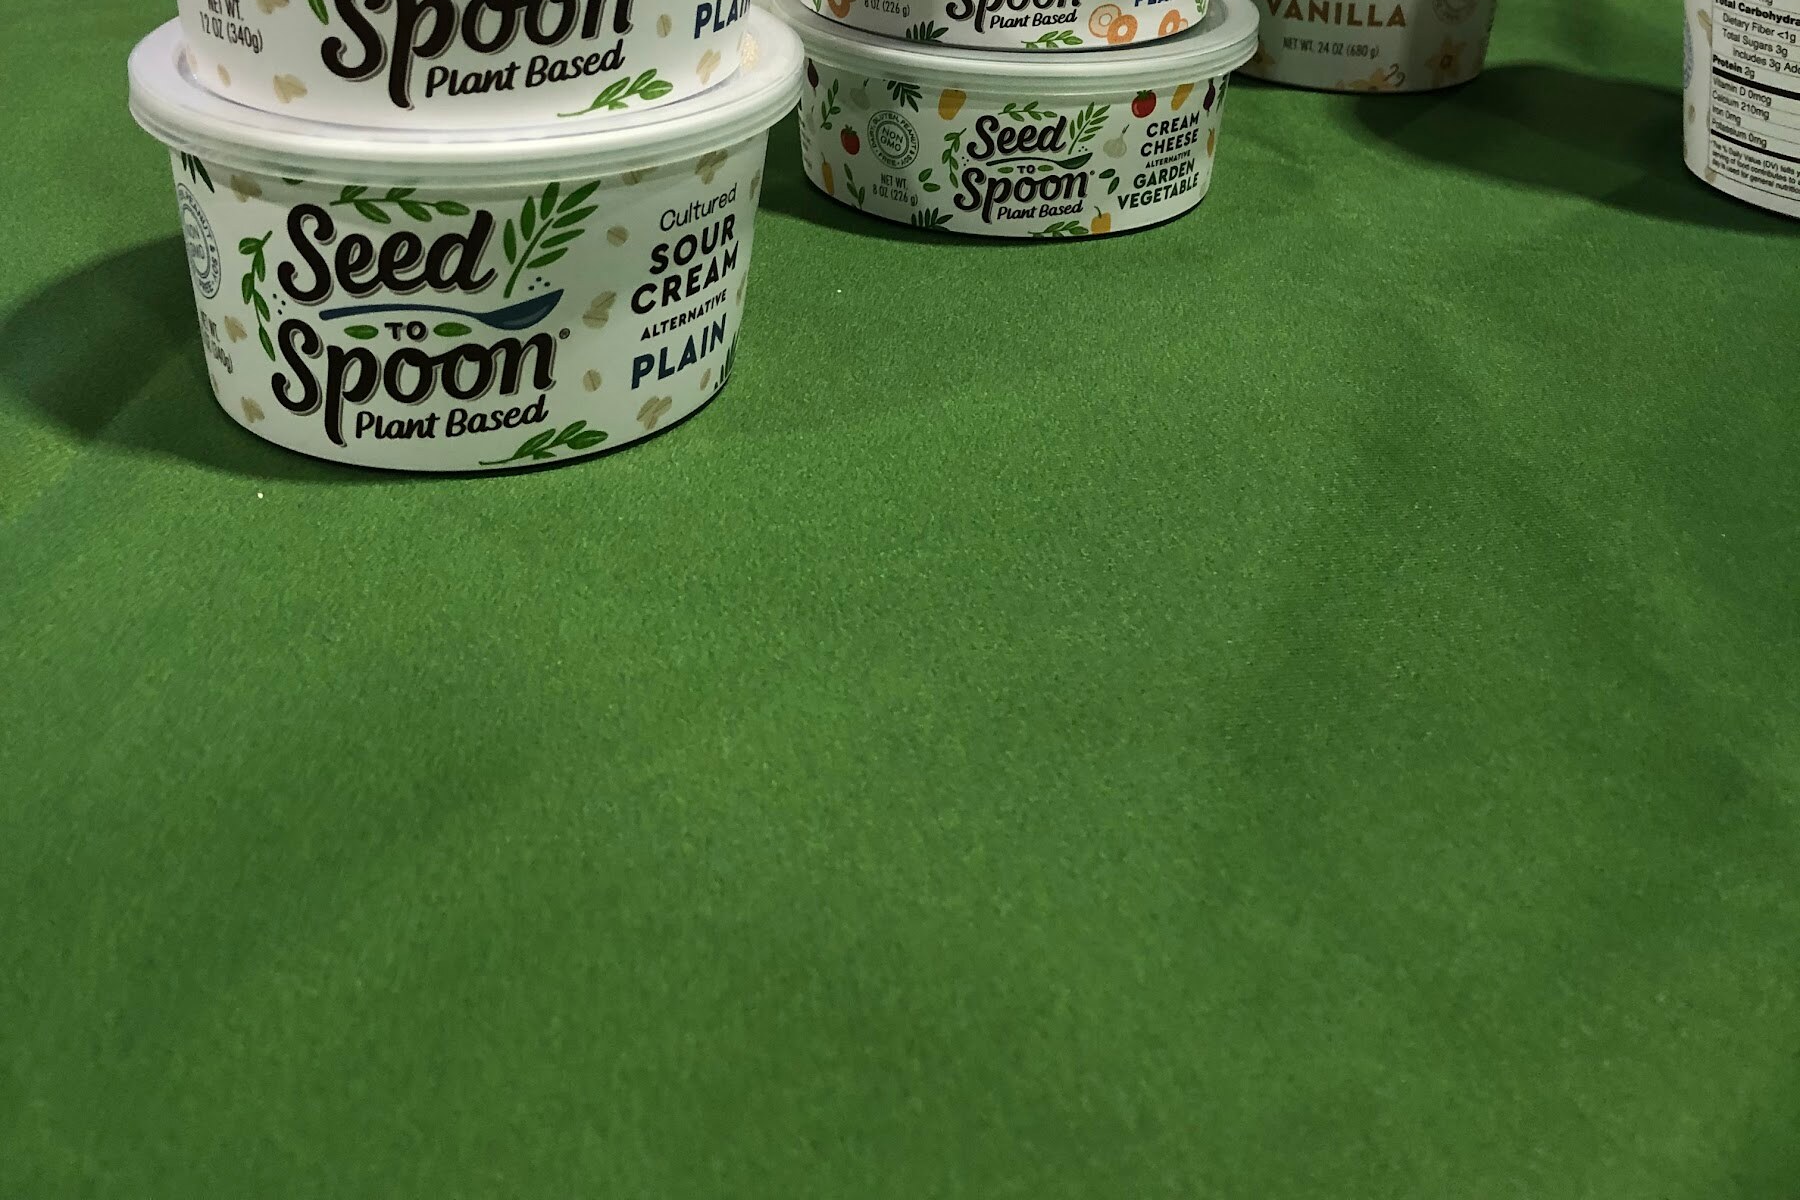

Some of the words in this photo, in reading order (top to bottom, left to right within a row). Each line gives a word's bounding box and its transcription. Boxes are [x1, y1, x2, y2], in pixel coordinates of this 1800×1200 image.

[212, 19, 224, 40] OZ
[227, 21, 263, 54] (340g)
[990, 14, 1030, 29] Plant
[1032, 9, 1078, 26] Based
[424, 61, 524, 99] Plant
[526, 38, 626, 89] Based
[966, 115, 1067, 159] Seed
[1141, 128, 1199, 157] CHEESE
[1147, 111, 1200, 137] CREAM
[1017, 165, 1036, 174] TO
[1134, 158, 1195, 189] GARDEN
[1146, 150, 1191, 169] ALTERNATIVE
[660, 182, 737, 232] Cultured
[954, 168, 1087, 224] Spoon
[997, 205, 1037, 220] Plant
[1039, 200, 1084, 219] Based
[1117, 172, 1199, 210] VEGETABLE
[276, 202, 496, 299] Seed
[649, 213, 735, 275] SOUR
[630, 239, 739, 315] CREAM
[385, 321, 427, 341] TO
[640, 288, 728, 341] ALTERNATIVE
[629, 313, 730, 390] PLAIN
[271, 319, 553, 446] Spoon
[354, 410, 443, 441] Plant
[446, 395, 548, 439] Based
